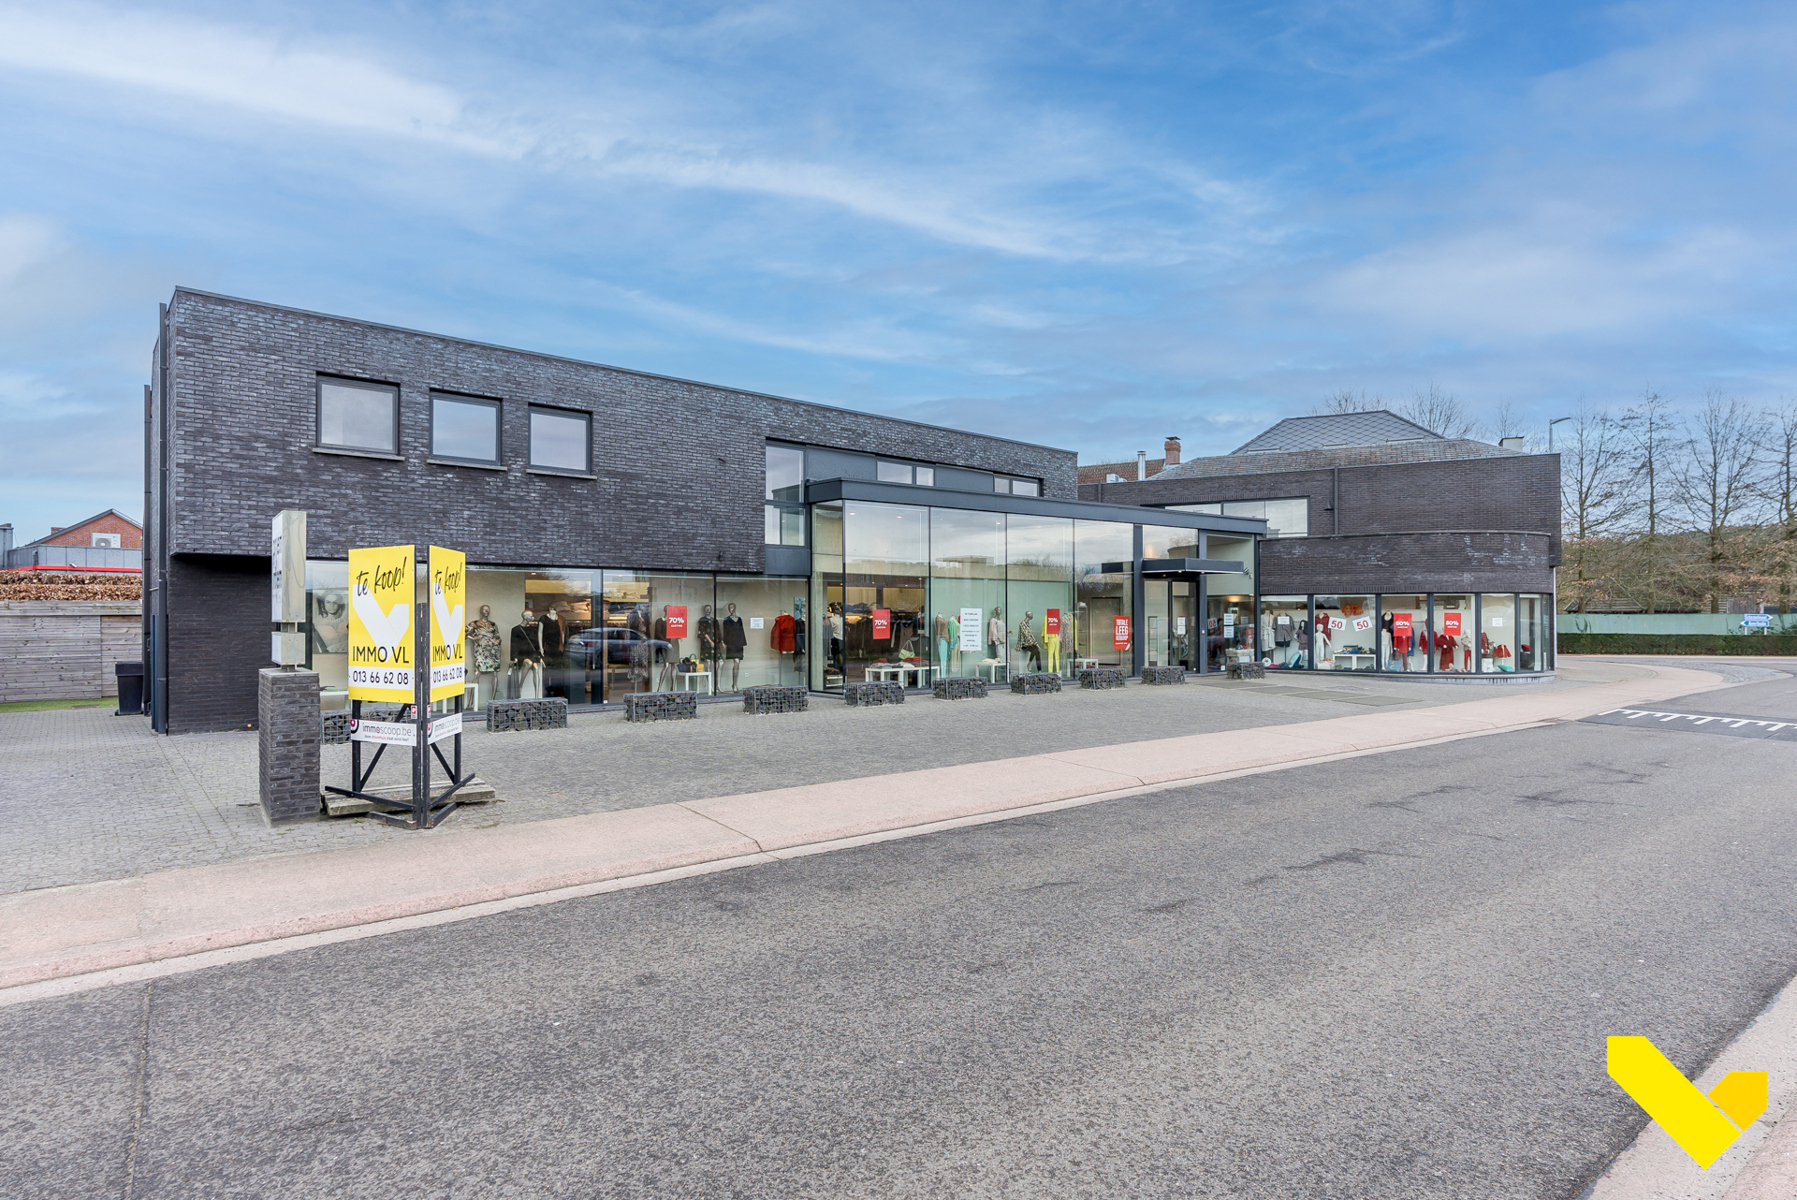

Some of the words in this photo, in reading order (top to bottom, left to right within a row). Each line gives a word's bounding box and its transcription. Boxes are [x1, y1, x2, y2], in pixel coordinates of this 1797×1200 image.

[356, 570, 369, 596] te
[374, 556, 407, 594] koop!
[434, 569, 442, 595] te
[444, 562, 462, 593] koop!
[1115, 625, 1128, 635] LEEG
[1331, 620, 1343, 629] 50
[1356, 620, 1369, 630] 50
[352, 646, 388, 662] IMMO
[391, 646, 409, 664] VL
[433, 645, 451, 662] IMMO
[453, 644, 462, 659] VL
[352, 670, 367, 683] 013
[369, 671, 380, 683] 66
[383, 672, 394, 684] 62
[397, 672, 409, 685] 08
[433, 671, 441, 683] 013
[442, 669, 448, 682] 66
[449, 668, 456, 679] 62
[456, 667, 463, 678] 08
[362, 722, 412, 737] immoscoop.be
